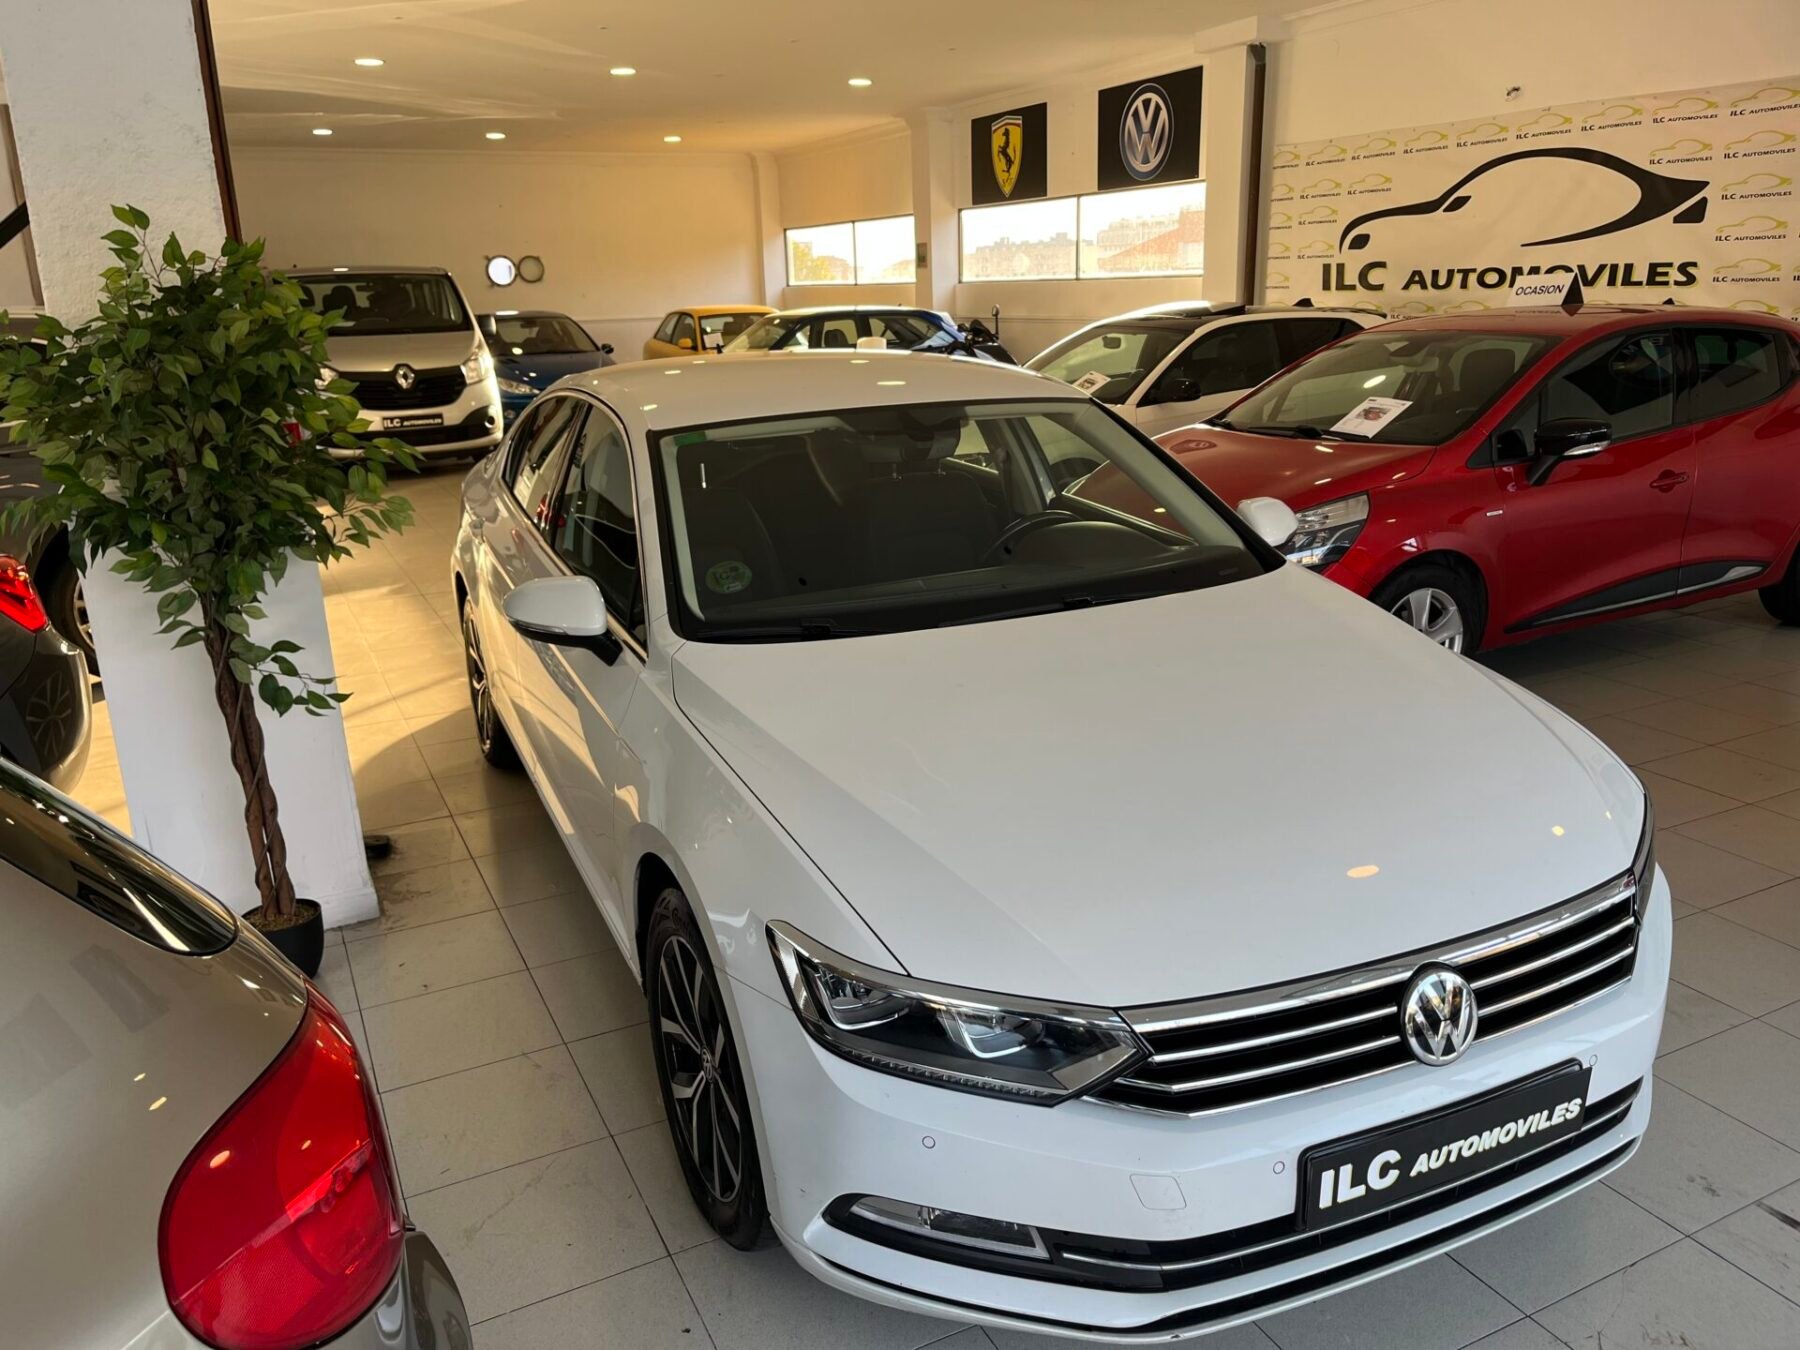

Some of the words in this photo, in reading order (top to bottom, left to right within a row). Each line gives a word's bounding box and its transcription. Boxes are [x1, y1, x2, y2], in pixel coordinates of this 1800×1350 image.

[1667, 114, 1718, 122] AUTOMOVILES
[1730, 109, 1746, 117] ILC
[1598, 120, 1642, 130] AUTOMOVILES
[1516, 132, 1530, 140] ILC
[1531, 129, 1572, 138] AUTOMOVILES
[1724, 152, 1740, 160] ILC
[1742, 147, 1796, 158] AUTOMOVILES
[1665, 156, 1713, 164] AUTOMOVILES
[1739, 191, 1792, 199] AUTOMOVILES
[1322, 261, 1387, 291] ILC
[1515, 284, 1565, 296] OCASION
[383, 418, 401, 428] ILC
[1318, 1149, 1402, 1210] ILC
[1409, 1097, 1583, 1178] AUTOMOVILES
